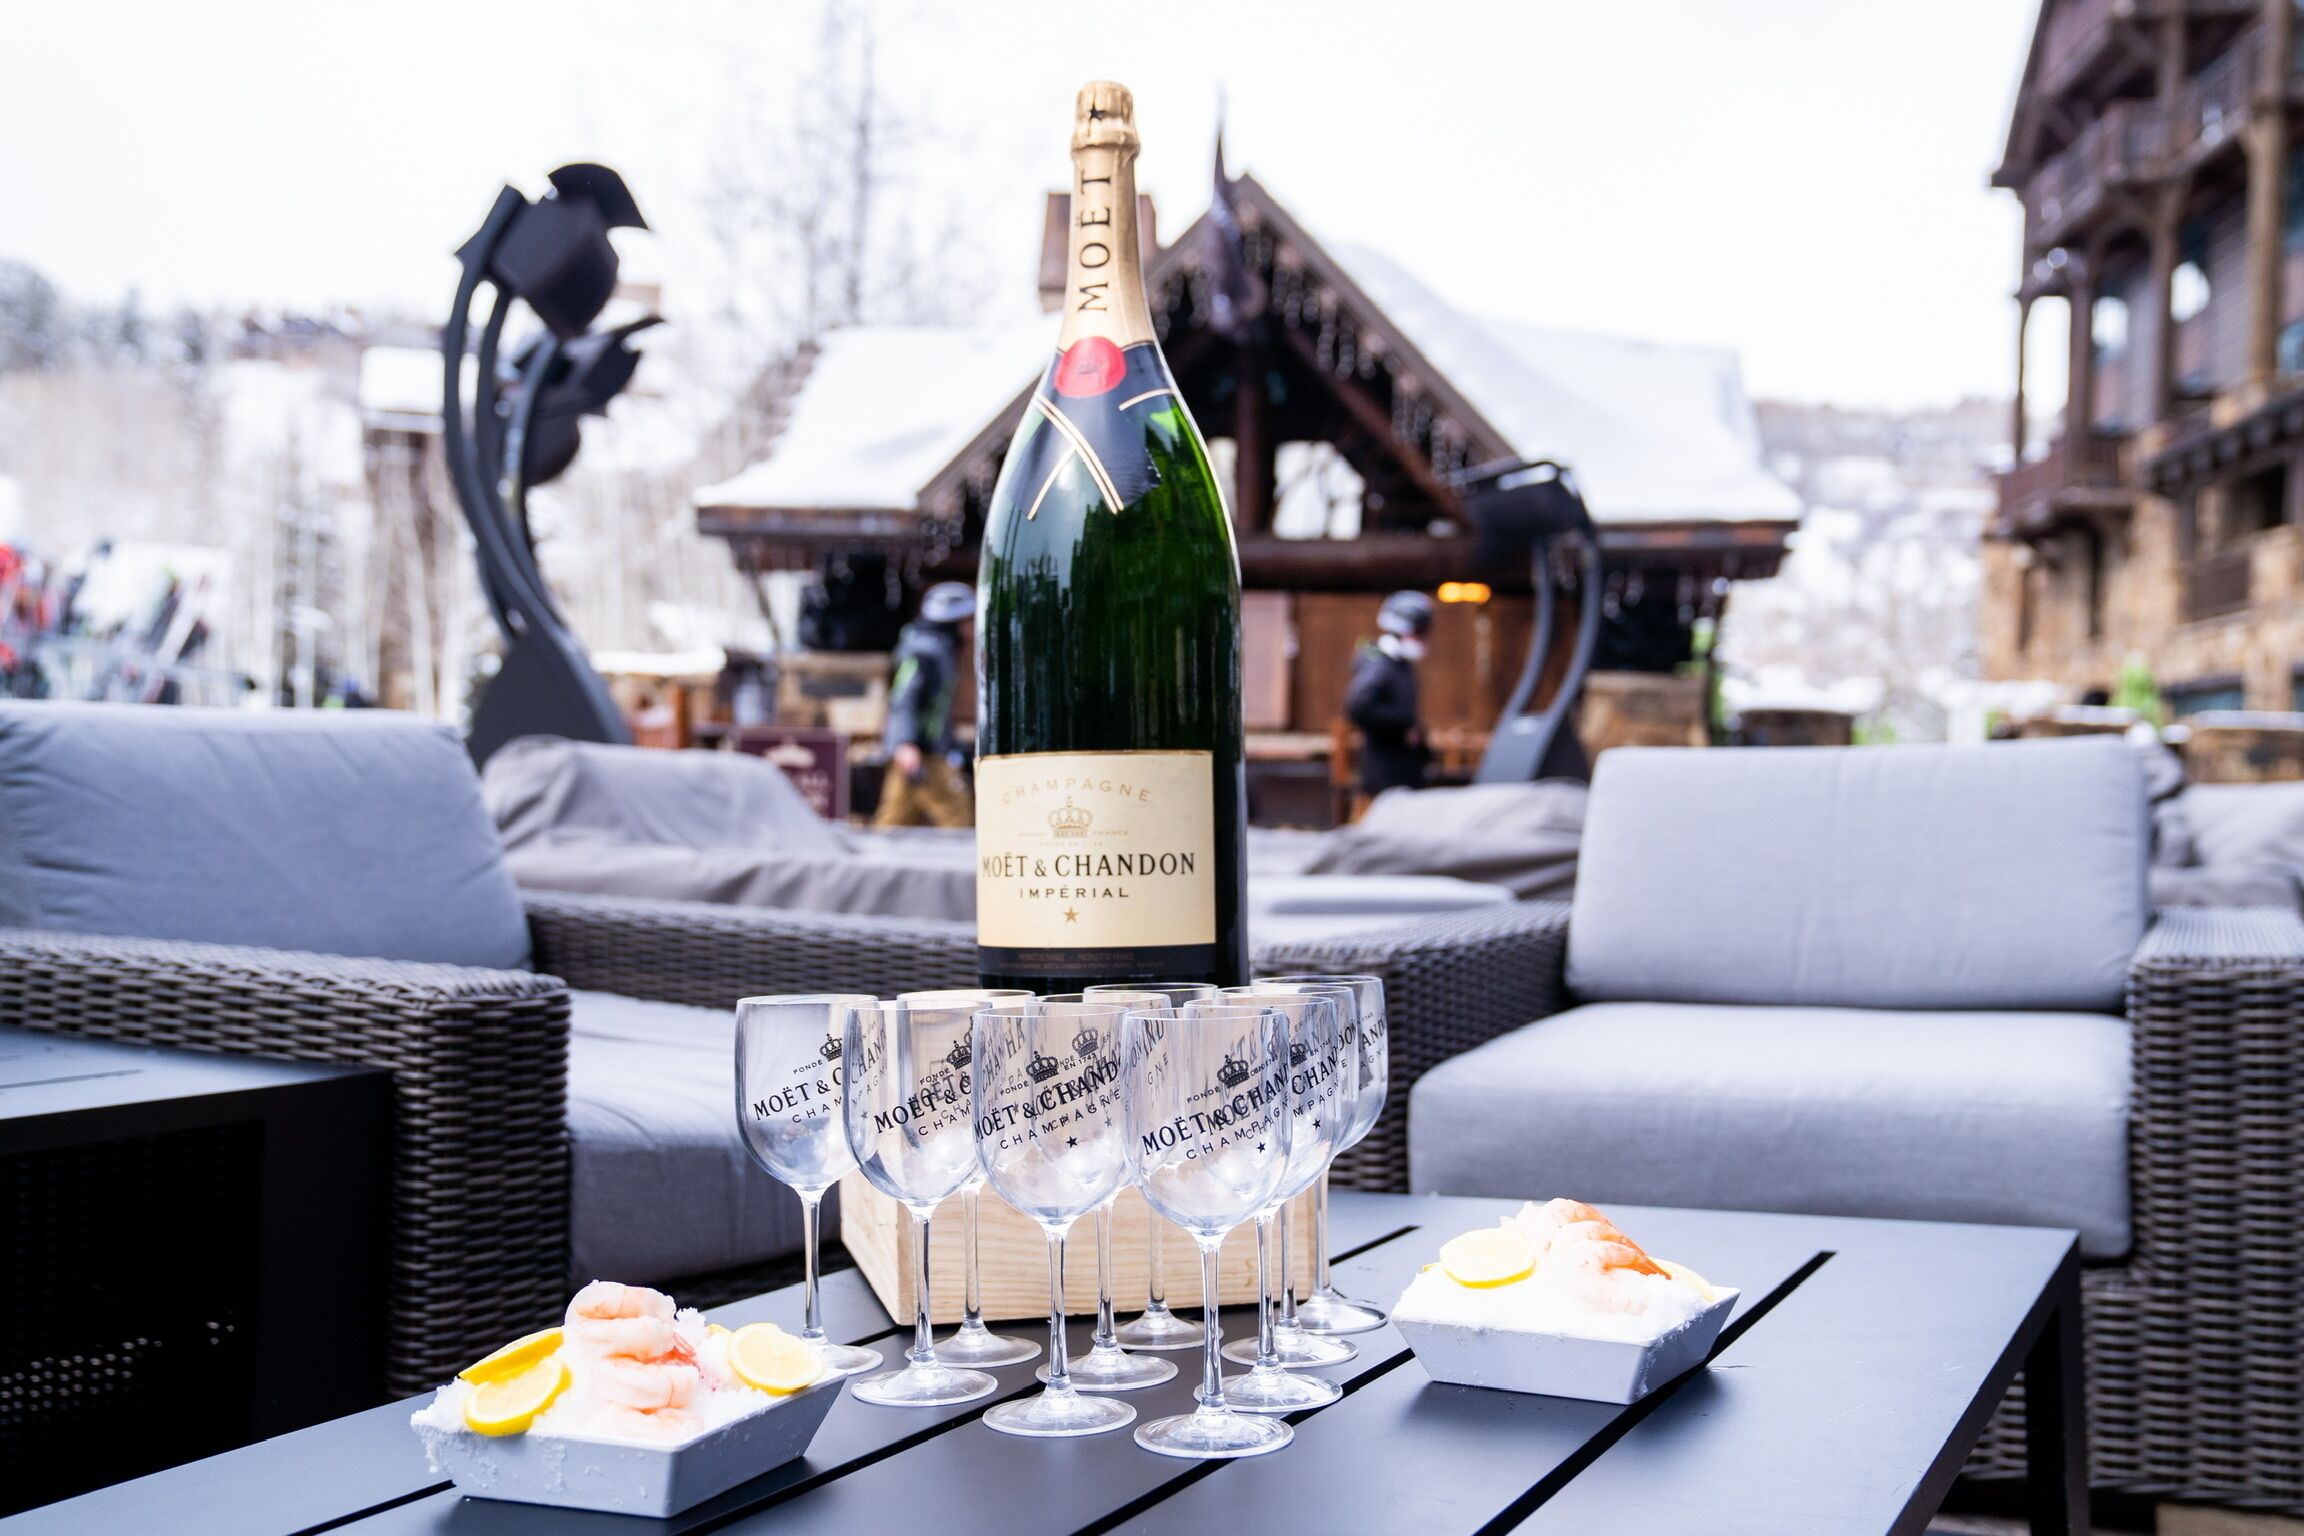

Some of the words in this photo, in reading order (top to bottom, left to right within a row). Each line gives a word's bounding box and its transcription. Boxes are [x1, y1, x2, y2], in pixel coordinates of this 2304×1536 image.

[1076, 170, 1111, 313] MOËT
[1003, 778, 1151, 804] CHAMPAGNE
[982, 852, 1029, 878] MOËT
[1034, 859, 1048, 878] &
[1055, 852, 1196, 878] CHANDON
[1020, 885, 1130, 899] IMPÉRIAL
[1079, 1052, 1097, 1065] 1743
[753, 1083, 811, 1121] MOËT
[816, 1079, 831, 1095] &
[874, 1092, 938, 1134] MOËT
[944, 1088, 959, 1105] &
[973, 1105, 1016, 1144] MOËT
[1023, 1102, 1037, 1119] &
[1141, 1110, 1207, 1156] MOËT
